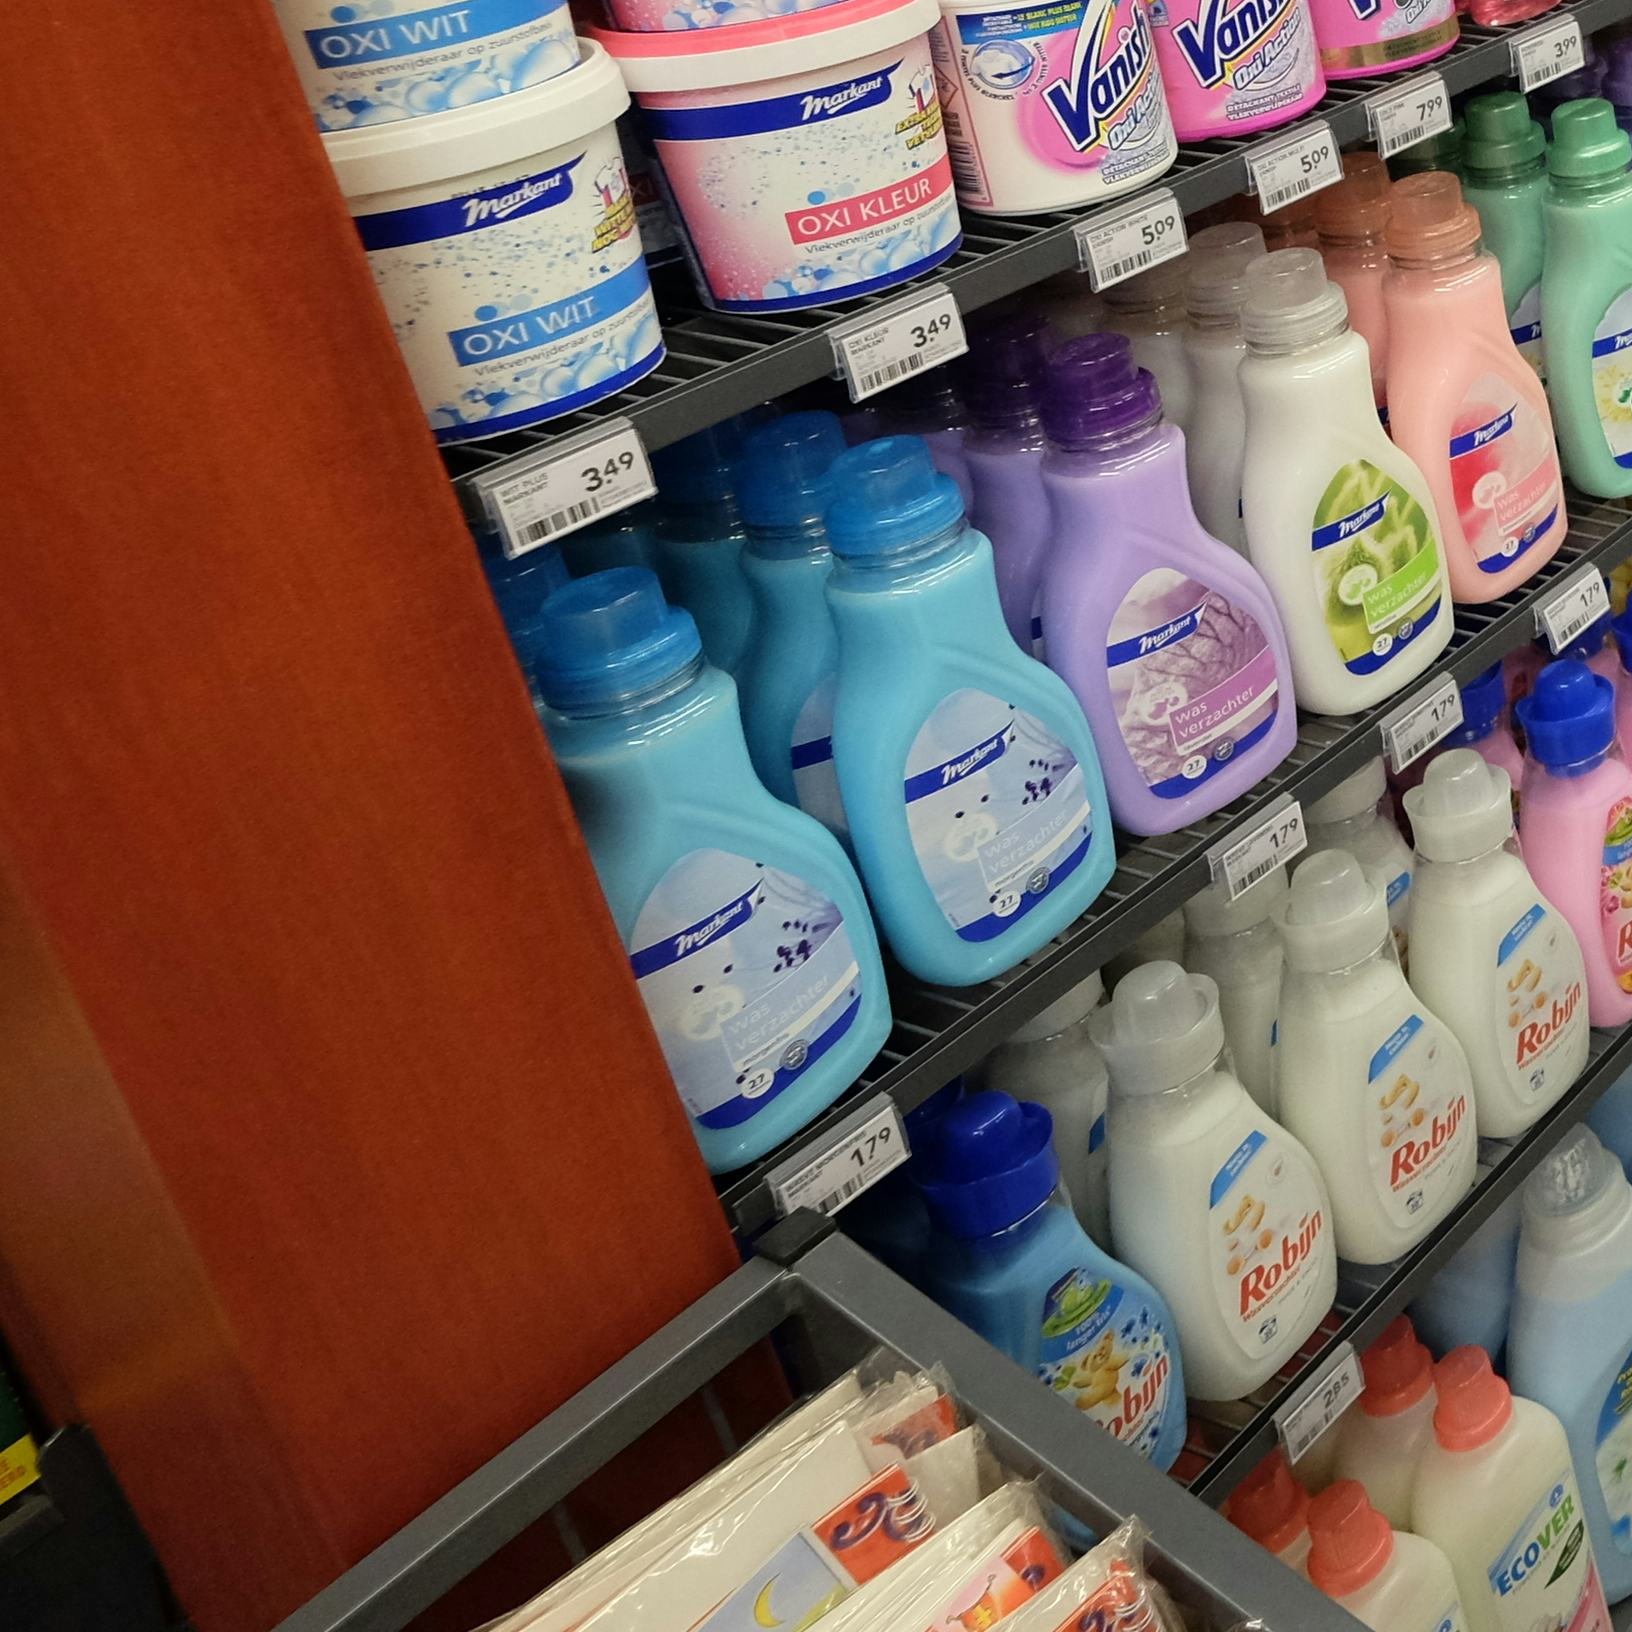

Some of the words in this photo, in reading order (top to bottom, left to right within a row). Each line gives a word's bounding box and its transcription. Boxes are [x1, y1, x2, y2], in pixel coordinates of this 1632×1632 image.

[321, 29, 391, 59] OXI
[399, 8, 469, 48] WIT
[799, 75, 883, 119] Markant
[1300, 146, 1330, 174] 5.09
[462, 172, 564, 226] Markant
[798, 207, 855, 237] OXI
[862, 179, 932, 219] KLEUR
[1142, 215, 1176, 246] 5.09
[464, 325, 529, 357] OXI
[536, 297, 595, 340] WIT
[910, 313, 952, 348] 3.49
[580, 451, 634, 493] 3.49
[1139, 615, 1191, 653] Markant
[1175, 702, 1209, 721] was
[1178, 685, 1254, 739] verzachter
[1270, 816, 1299, 852] 1.79
[673, 901, 743, 955] Markant
[1515, 982, 1581, 1070] Robijn
[851, 1126, 891, 1168] 1.79
[1389, 1095, 1467, 1187] Robijn
[1239, 1209, 1323, 1316] Robijn
[1495, 1493, 1576, 1596] ECOVER
